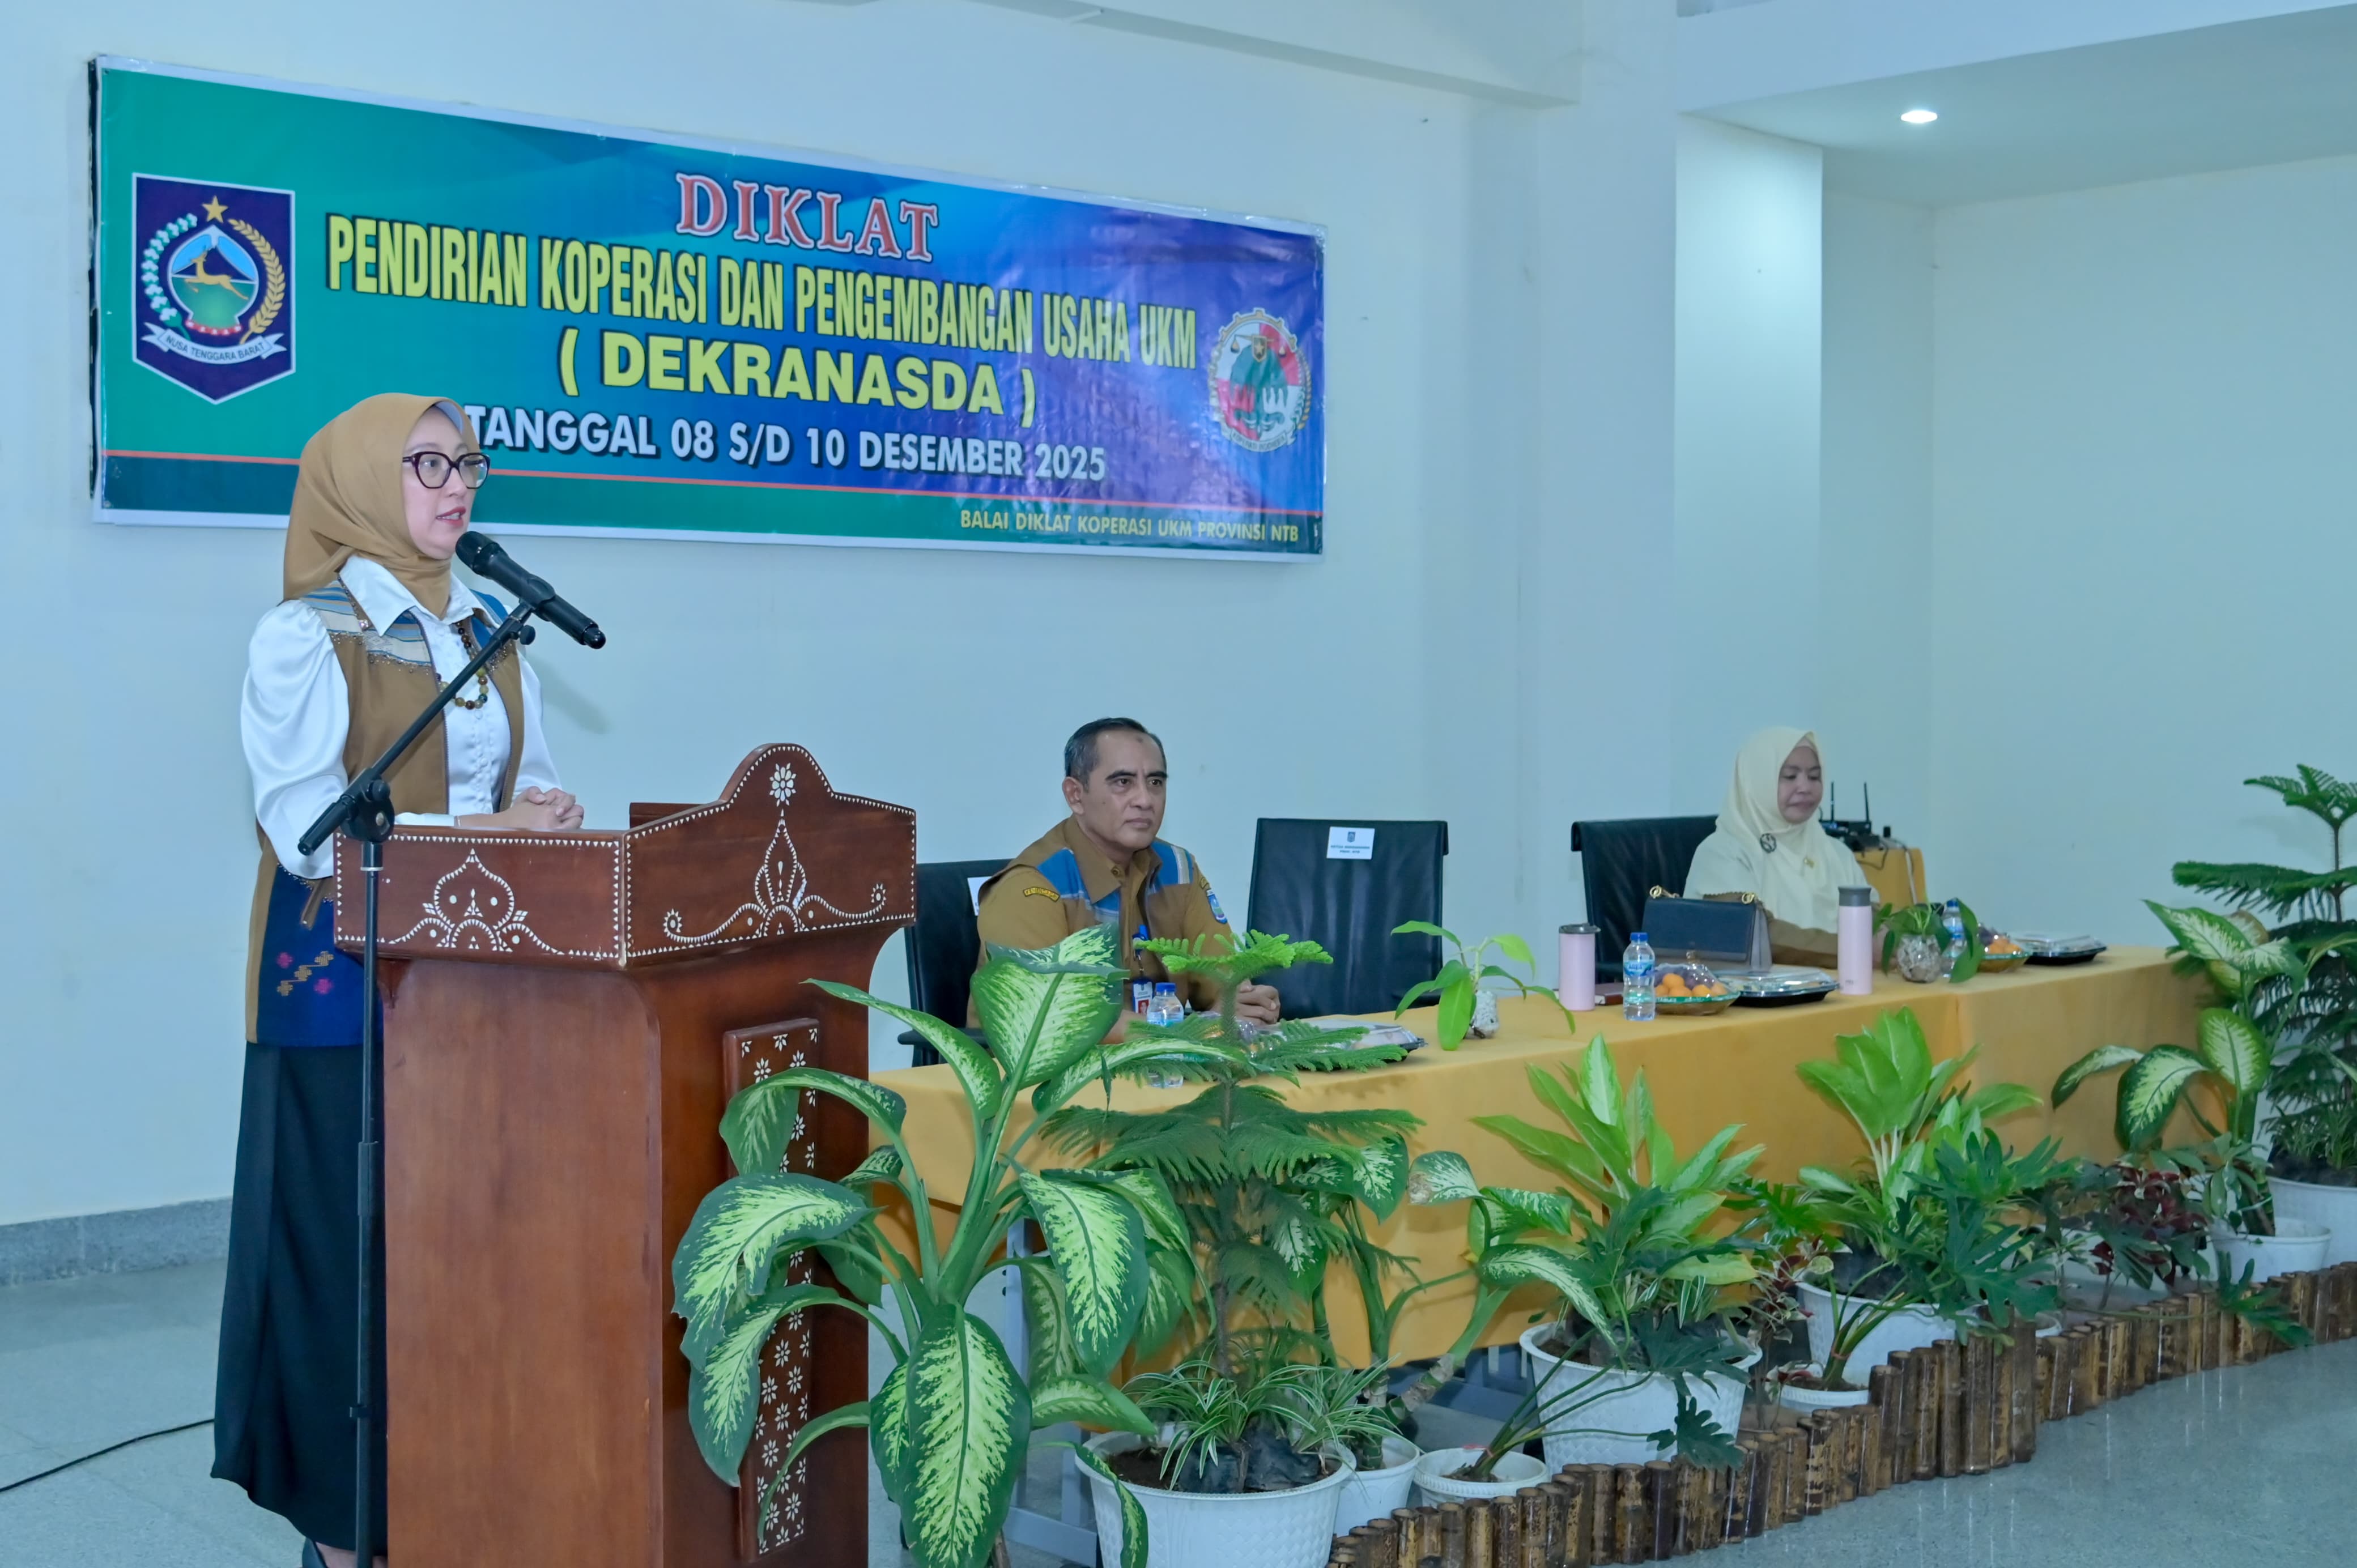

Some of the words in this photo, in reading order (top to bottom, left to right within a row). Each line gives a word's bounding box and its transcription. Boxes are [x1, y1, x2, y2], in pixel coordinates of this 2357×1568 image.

[675, 173, 939, 262] DIKLAT
[327, 214, 527, 308] PENDIRIAN
[541, 237, 707, 324] KOPERASI
[720, 257, 784, 330] DAN
[795, 266, 1033, 354] PENGEMBANGAN
[1043, 292, 1131, 363] USAHA
[1139, 304, 1196, 369] UKM
[166, 335, 188, 352] NUSA
[190, 347, 237, 361] TENGGARA
[238, 342, 265, 359] BARAT
[602, 331, 1005, 415] DEKRANASDA
[464, 404, 656, 455] TANGGAL
[671, 419, 714, 459] 08
[729, 421, 790, 466] S/D
[807, 428, 845, 467] 10
[860, 431, 1023, 476] DESEMBER
[1035, 443, 1106, 481] 2025
[960, 510, 1009, 530] BALAI
[1015, 513, 1071, 532] DIKLAT
[1078, 515, 1152, 536] KOPERASI
[1158, 519, 1192, 537] UKM
[1198, 521, 1266, 540] PROVINSI
[1271, 525, 1299, 542] NTB
